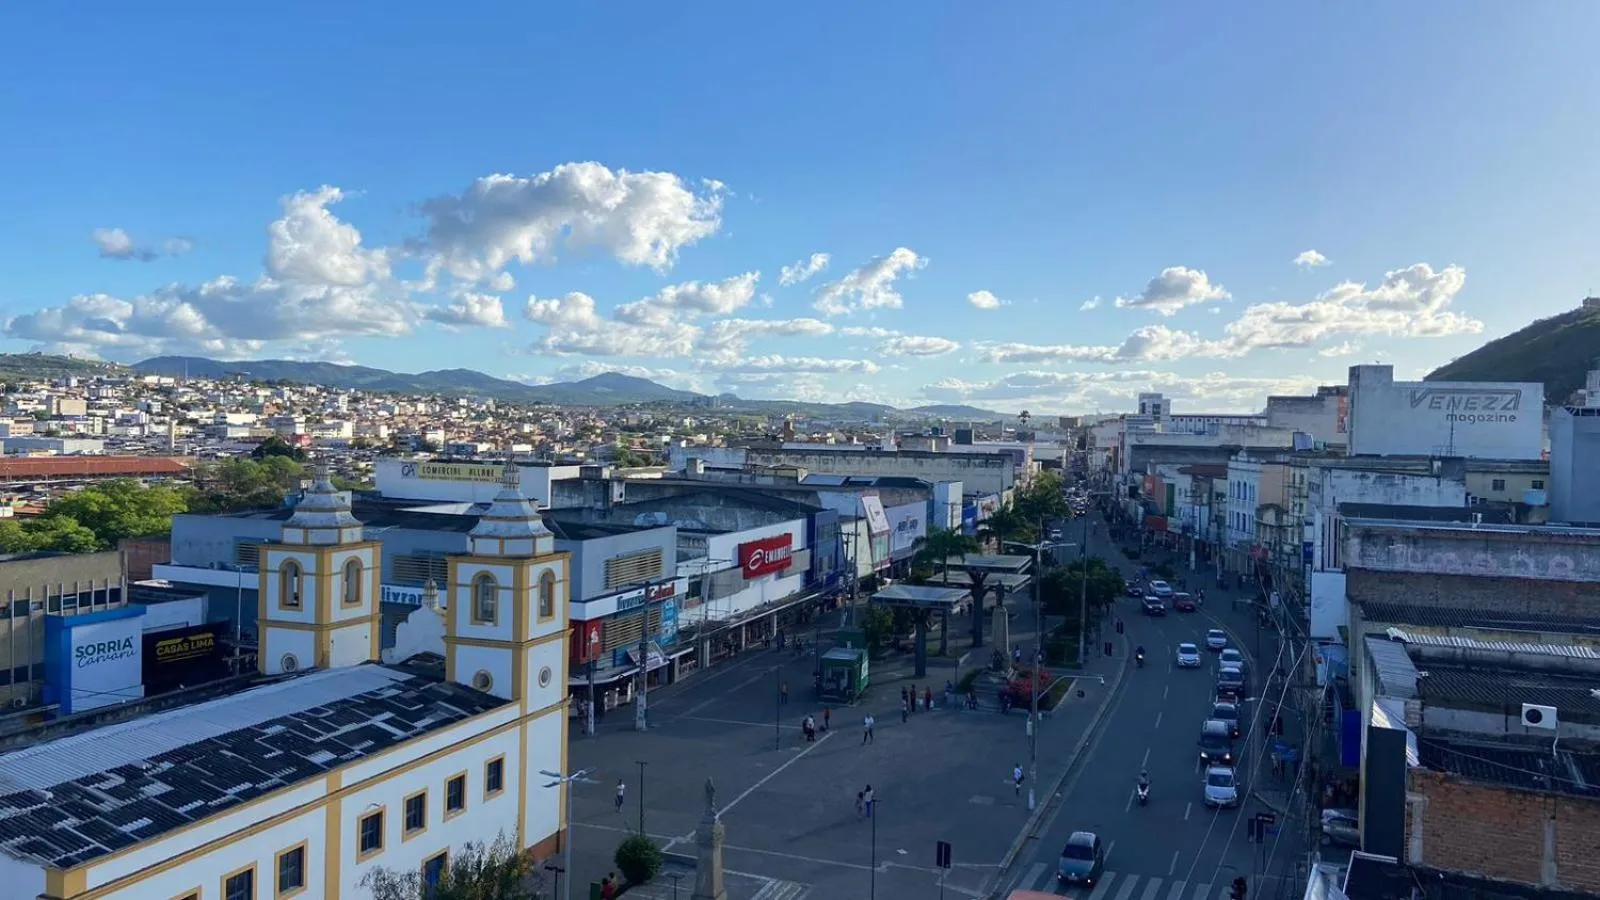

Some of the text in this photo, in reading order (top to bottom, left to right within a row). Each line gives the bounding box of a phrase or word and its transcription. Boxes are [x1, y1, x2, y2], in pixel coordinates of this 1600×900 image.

[1446, 413, 1517, 425] magazine
[422, 466, 461, 476] COMERCIAL
[75, 637, 133, 659] SORRIA
[156, 638, 214, 657] CASAS LIMA
